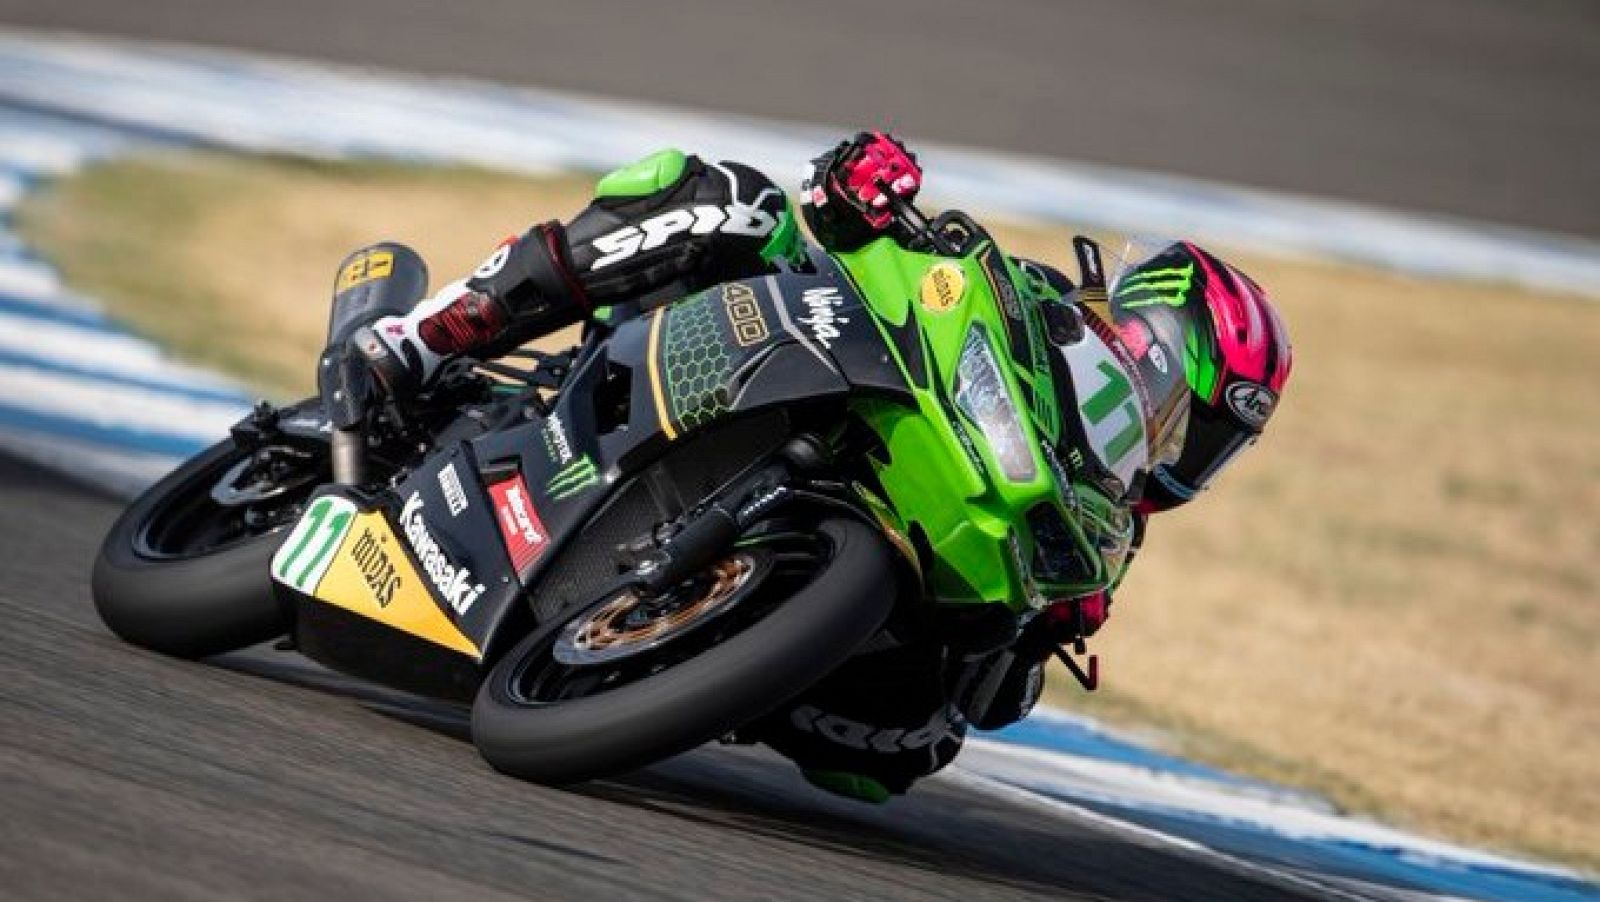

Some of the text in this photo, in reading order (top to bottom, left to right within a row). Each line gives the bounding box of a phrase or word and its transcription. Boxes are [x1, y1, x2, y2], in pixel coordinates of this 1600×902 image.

[590, 205, 783, 271] SPID
[722, 282, 770, 347] 400
[797, 287, 850, 349] Ninja
[1080, 359, 1144, 466] 11
[278, 499, 352, 587] 11
[399, 490, 486, 616] Kawasaki
